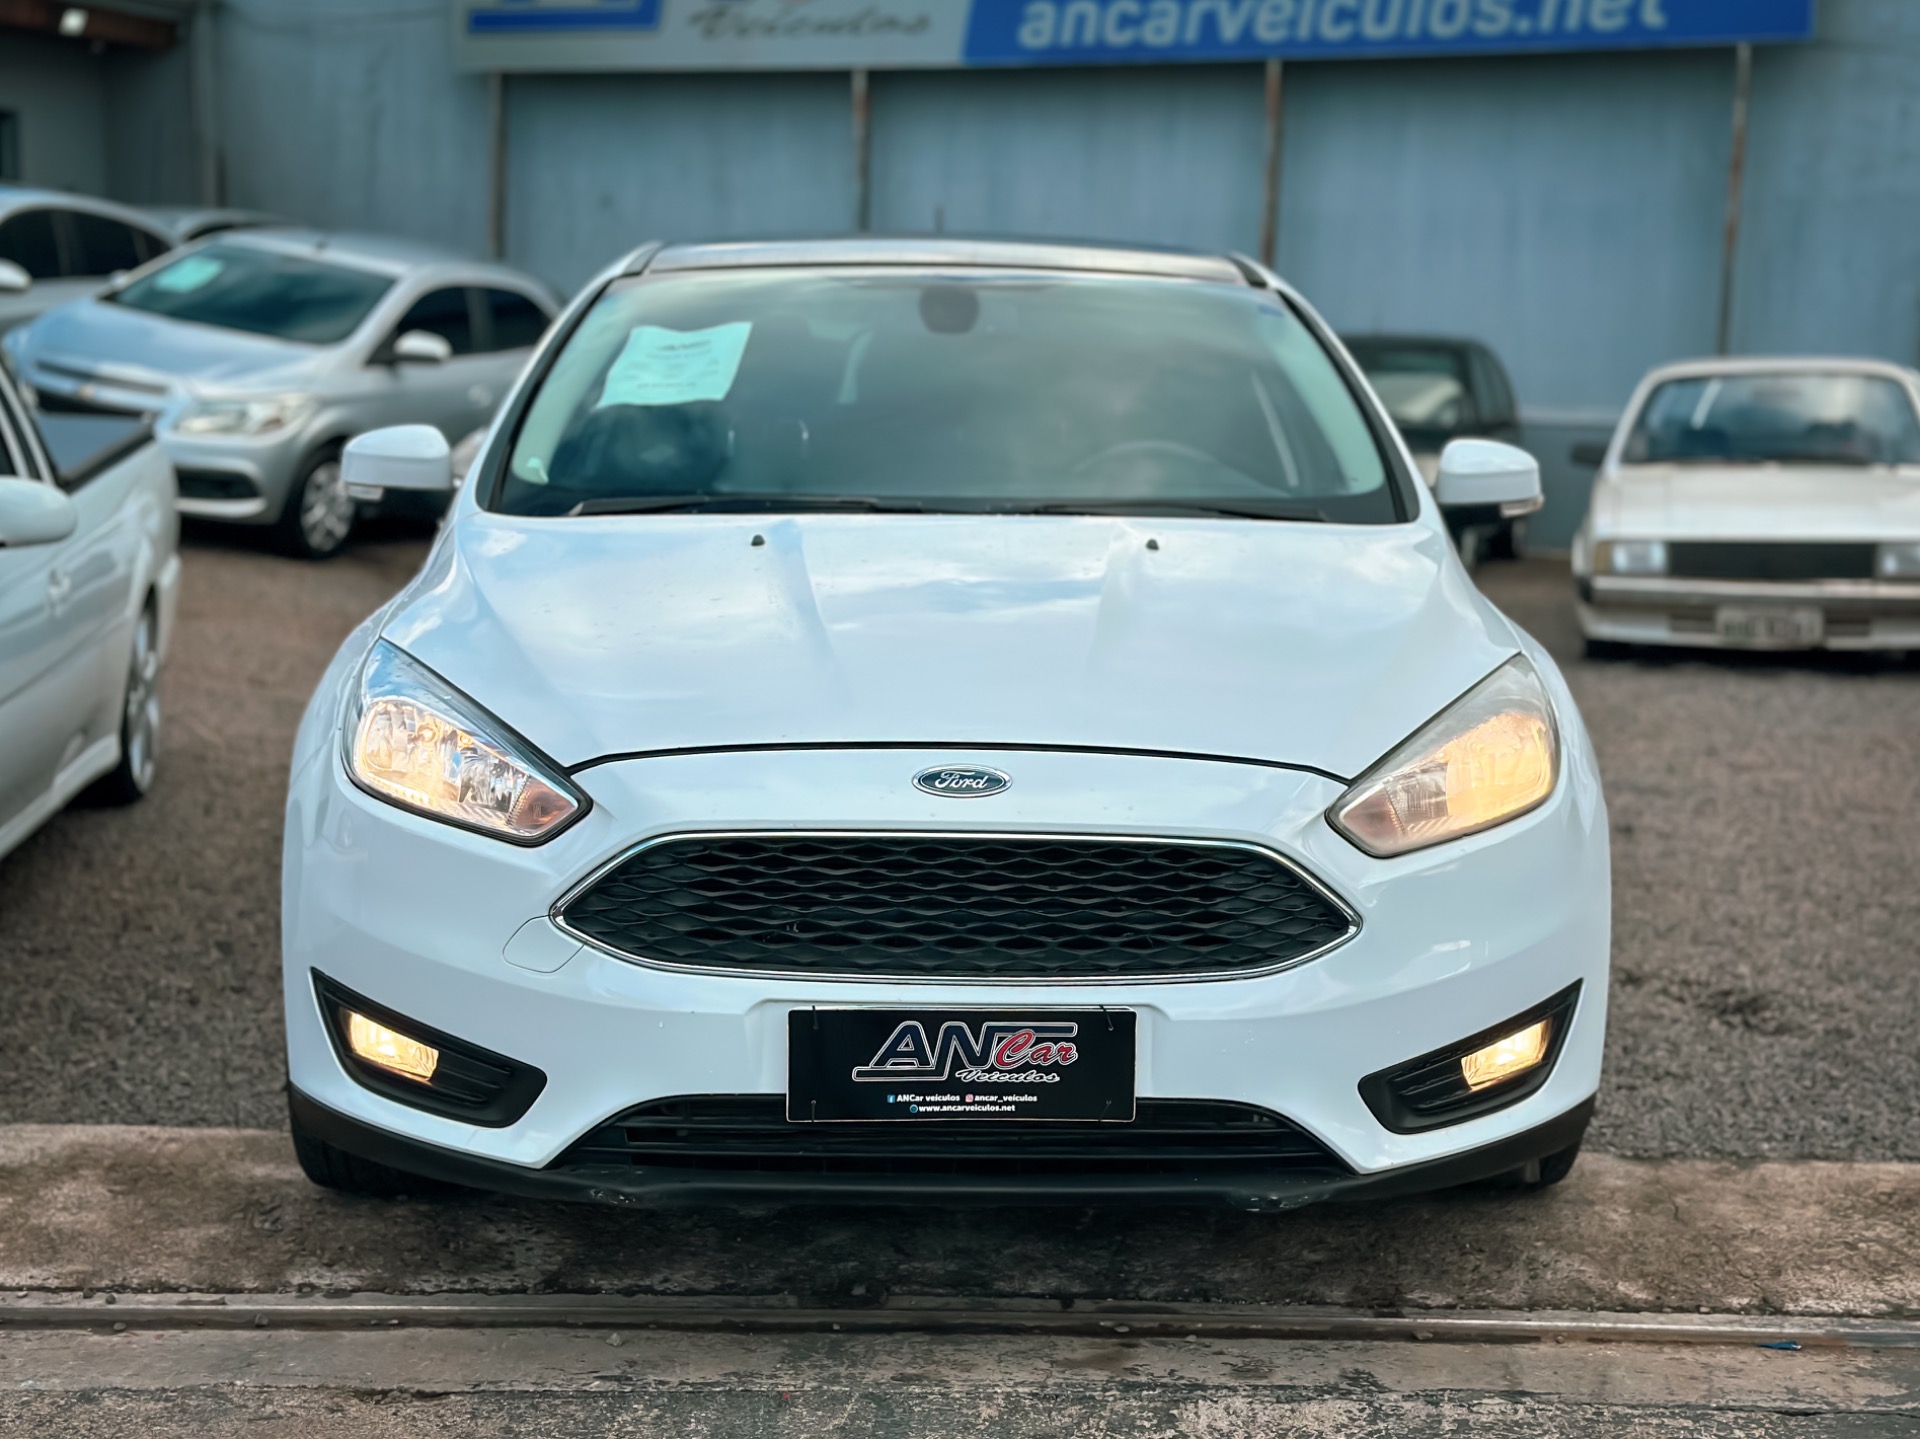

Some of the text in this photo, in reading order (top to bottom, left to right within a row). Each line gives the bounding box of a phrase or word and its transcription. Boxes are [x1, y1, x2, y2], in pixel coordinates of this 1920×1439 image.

[934, 771, 989, 789] Ford
[896, 1094, 924, 1102] ANCar
[918, 1104, 1016, 1112] www.ancarveiculos.net
